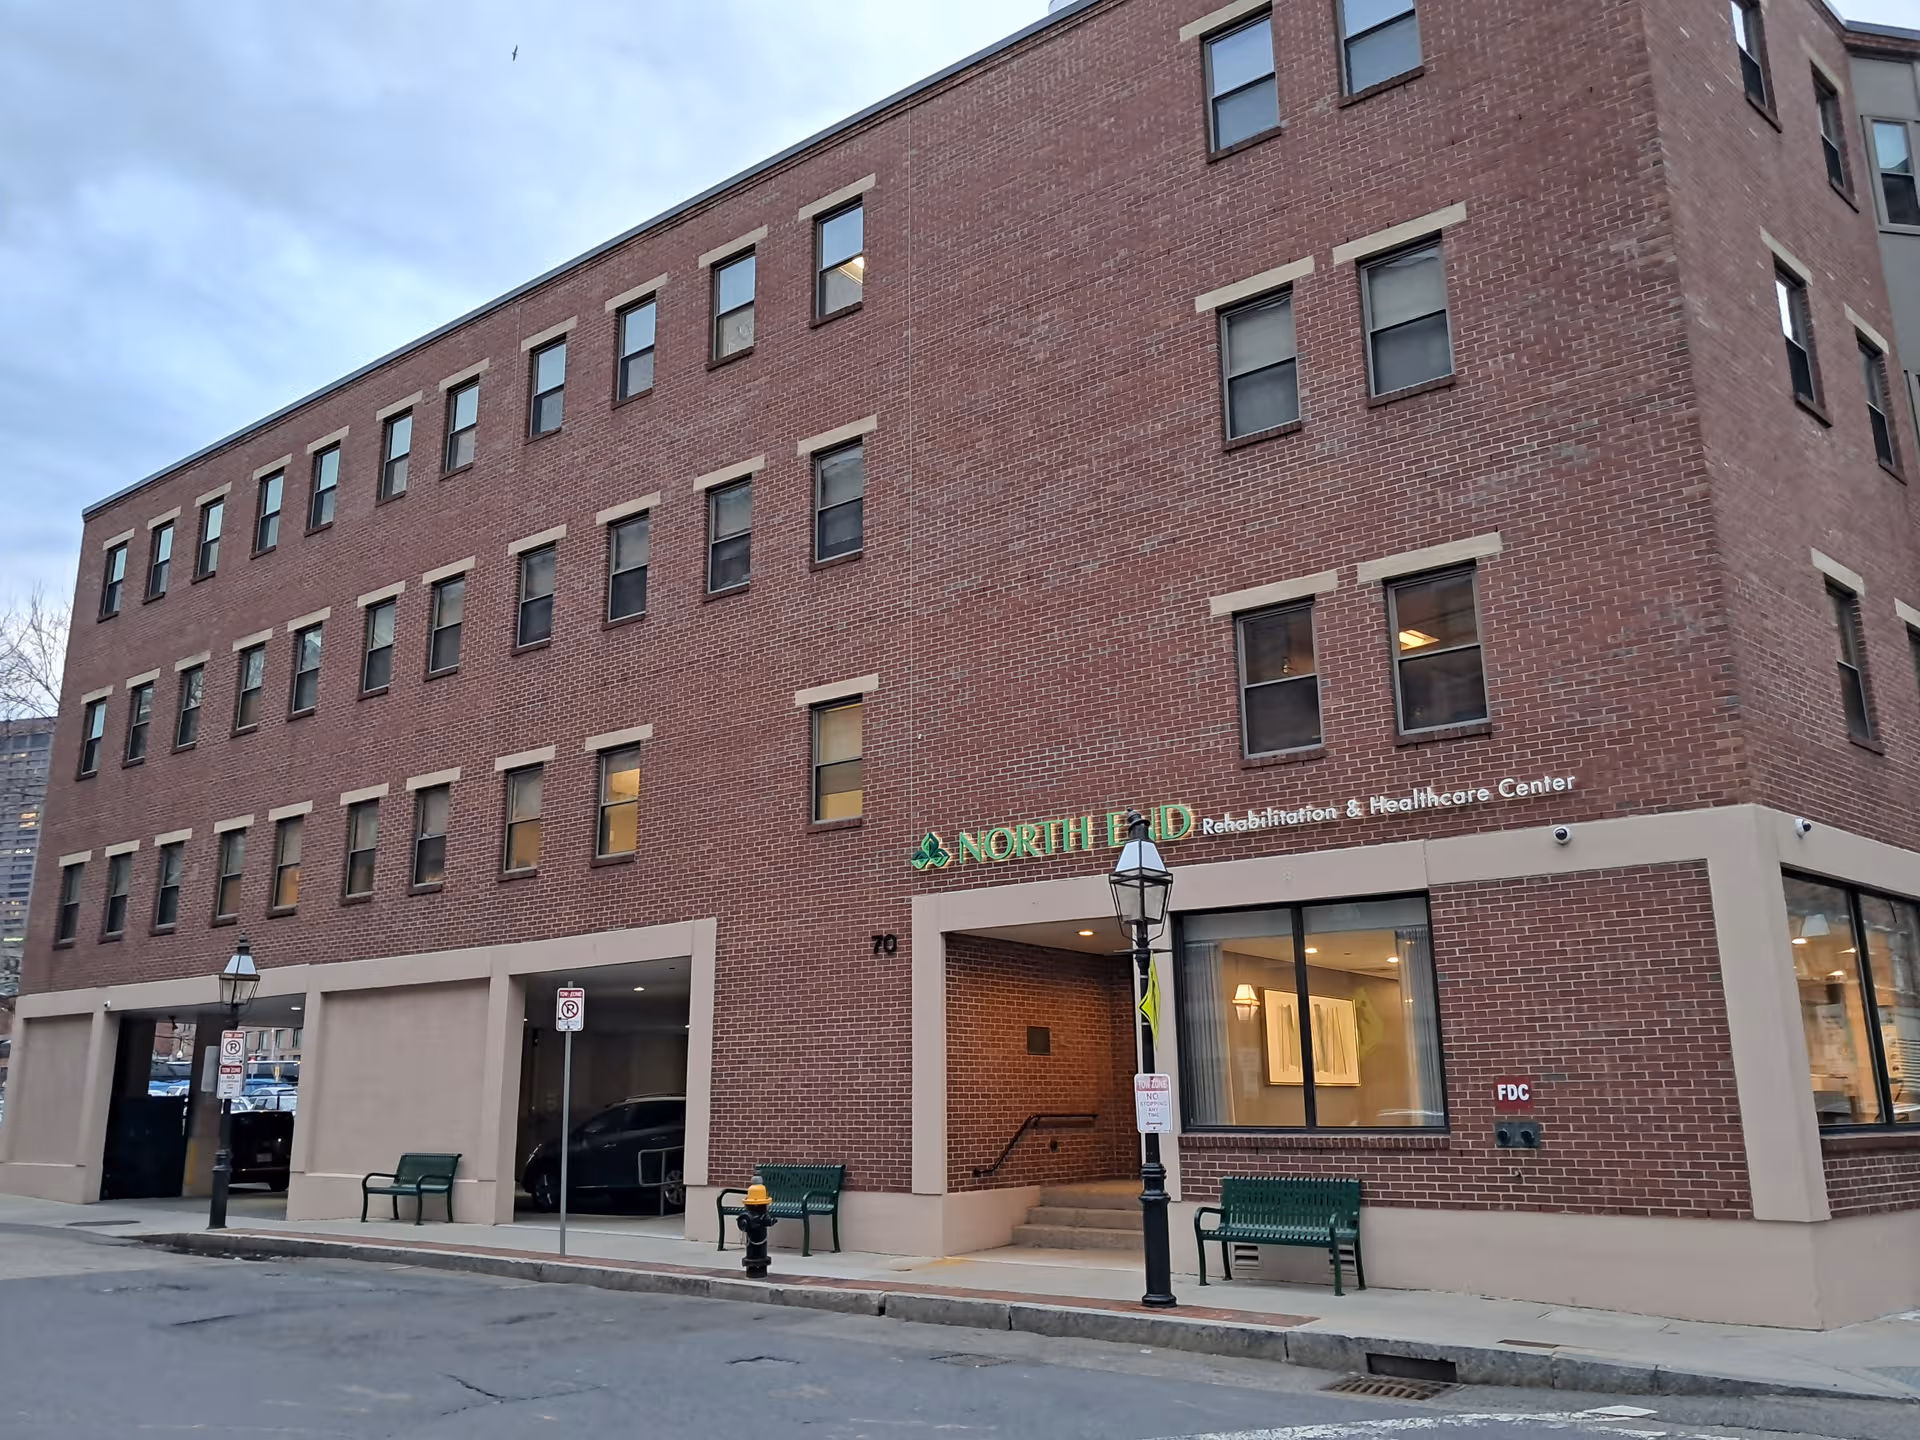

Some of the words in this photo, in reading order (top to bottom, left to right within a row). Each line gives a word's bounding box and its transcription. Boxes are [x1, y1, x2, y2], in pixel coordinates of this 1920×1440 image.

[1202, 805, 1337, 834] Rehabilitation
[1346, 799, 1361, 817] &
[1370, 787, 1489, 814] Healthcare
[1498, 775, 1576, 798] Center
[958, 815, 1089, 864] NORTH
[871, 934, 897, 955] 70
[1497, 1084, 1530, 1101] FDC
